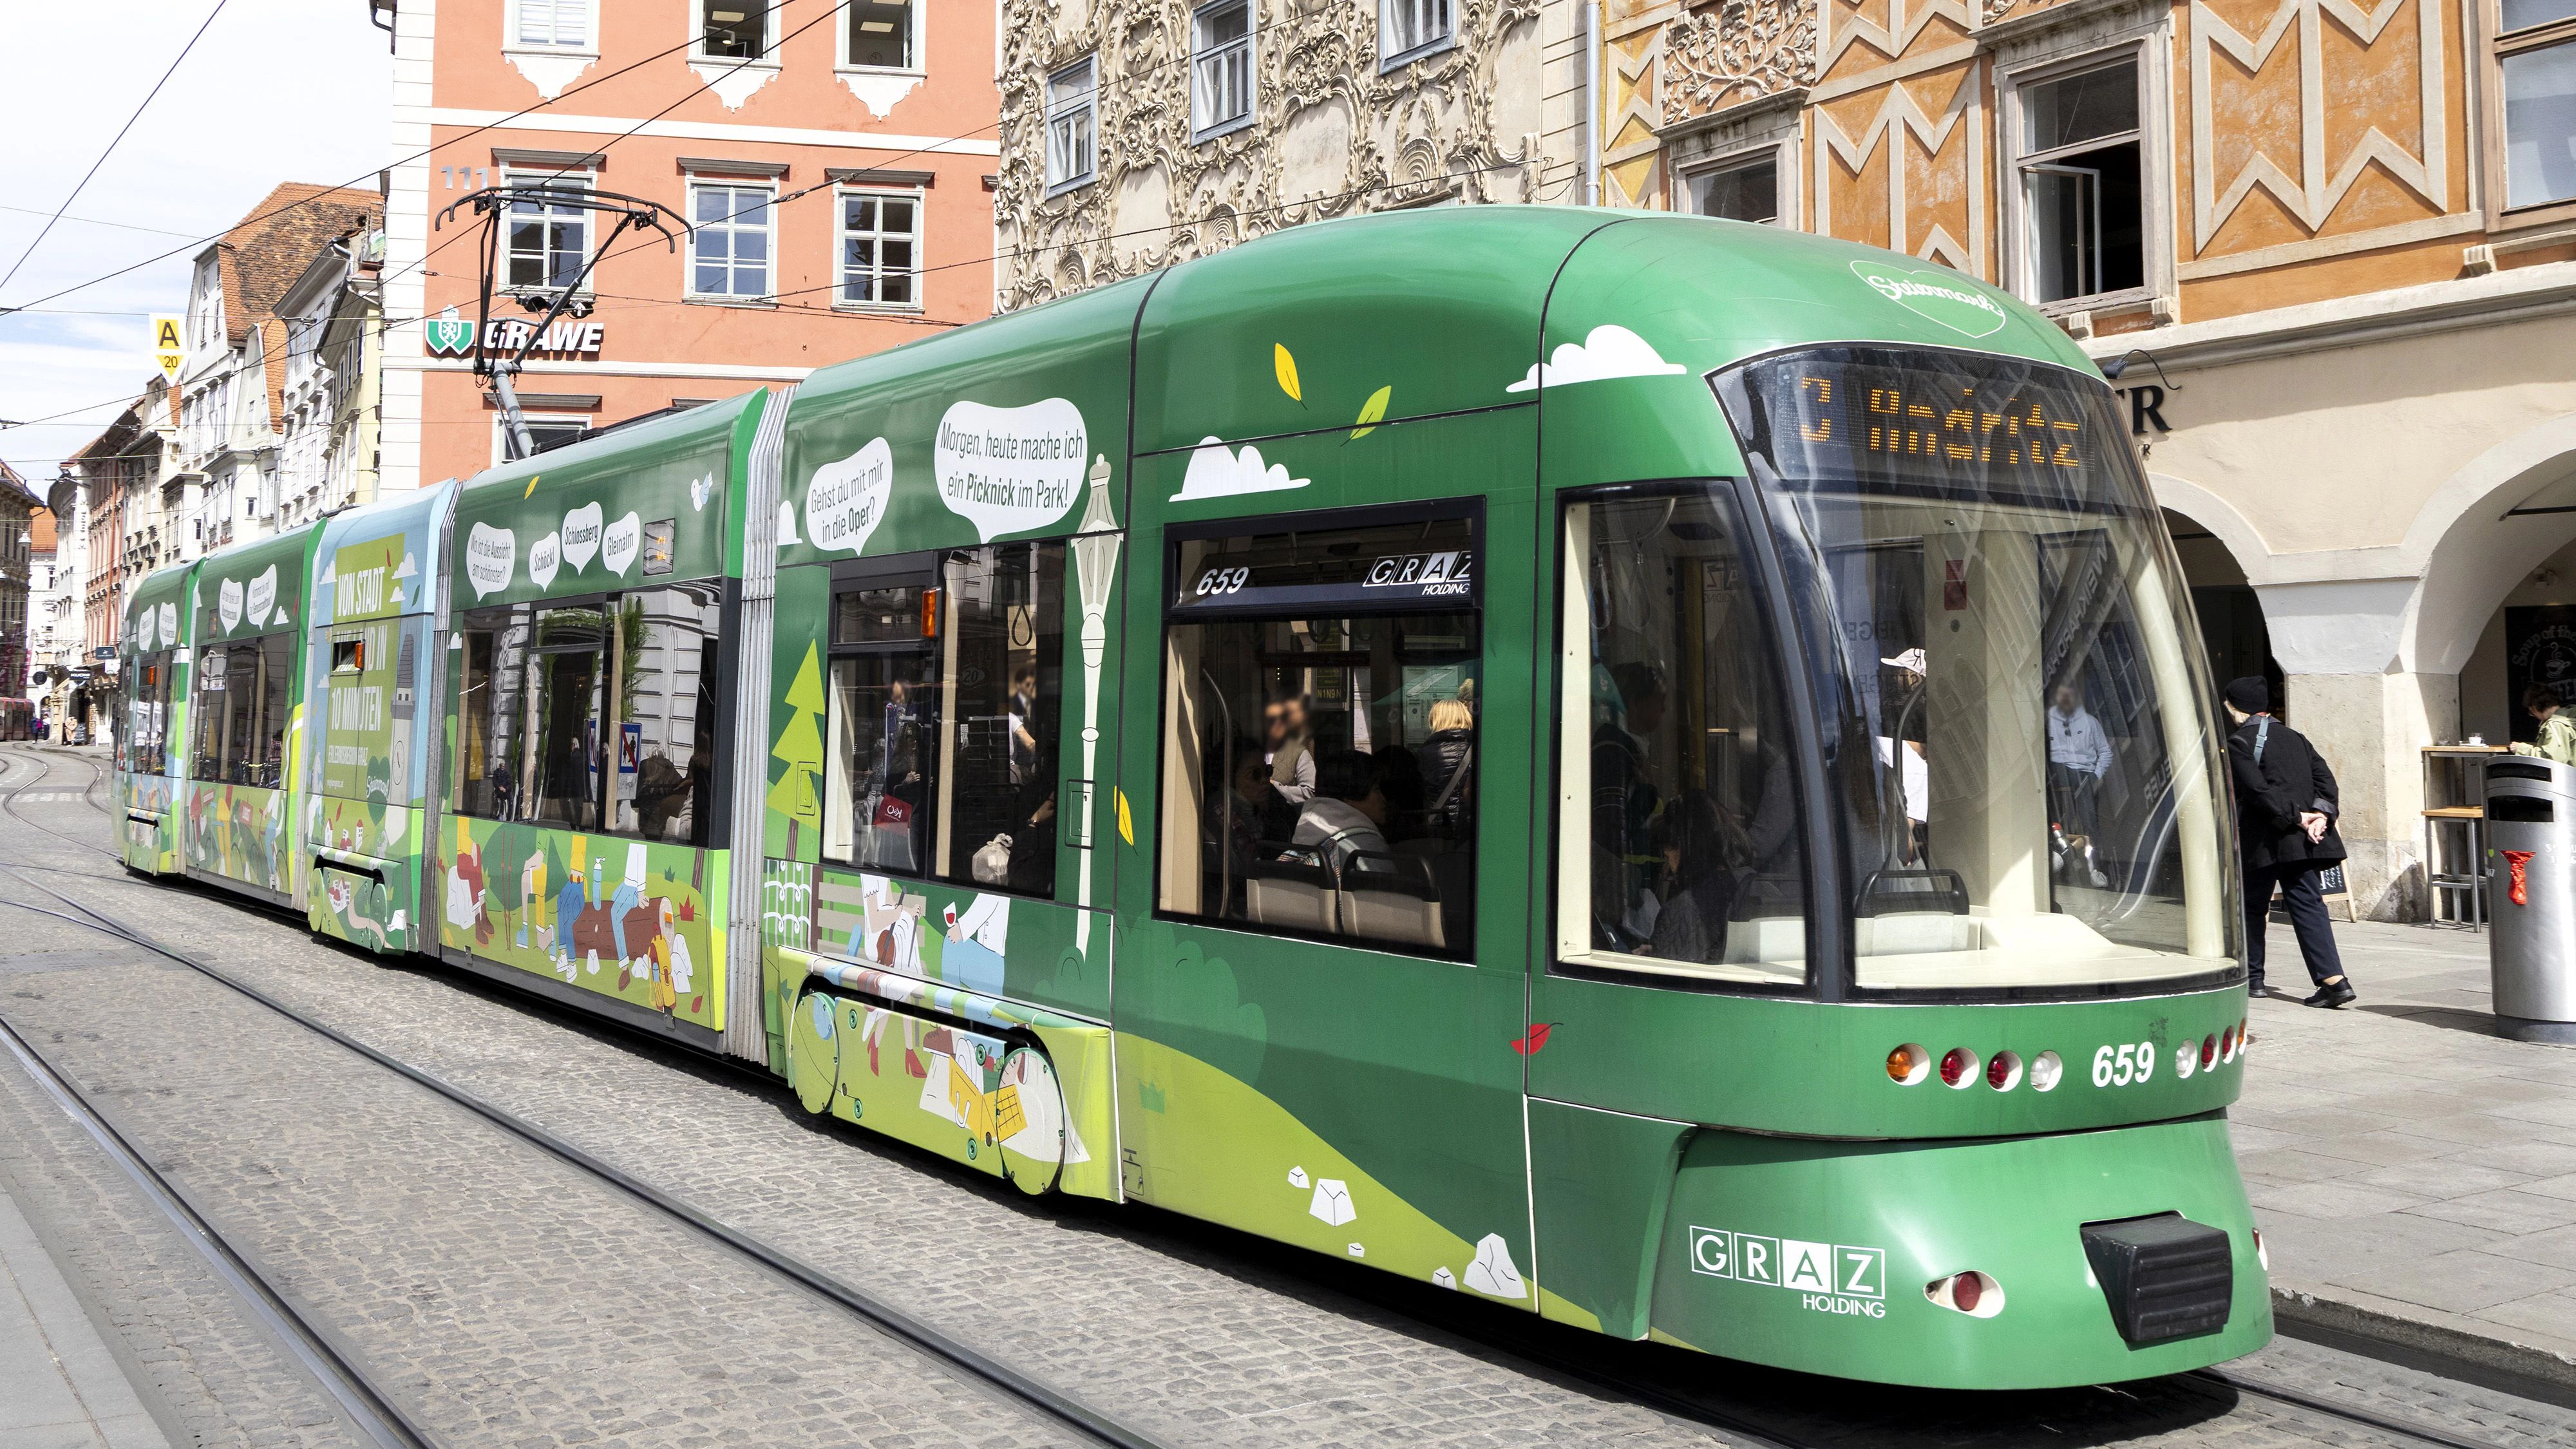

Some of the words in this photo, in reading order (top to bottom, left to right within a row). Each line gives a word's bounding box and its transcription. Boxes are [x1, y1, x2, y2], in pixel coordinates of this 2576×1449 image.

[440, 165, 488, 190] 111
[1867, 273, 2005, 315] Steiermark
[158, 321, 180, 346] A
[484, 321, 604, 352] GRAWE
[164, 355, 178, 368] 20
[940, 422, 982, 460] Morgen,
[985, 431, 1017, 460] heute
[1021, 431, 1061, 460] mache
[1065, 430, 1083, 459] ich
[811, 485, 836, 515] Gehst
[837, 479, 849, 506] du
[851, 470, 867, 500] mit
[868, 460, 884, 489] mir
[948, 471, 964, 500] ein
[967, 473, 1015, 507] Picknick
[1018, 478, 1033, 507] im
[1036, 478, 1068, 509] Park!
[565, 523, 598, 546] Schlossberg
[822, 519, 831, 544] in
[833, 512, 847, 540] die
[848, 497, 876, 536] Oper?
[491, 540, 511, 560] Aussicht
[607, 530, 634, 556] Gleinalm
[472, 565, 479, 577] am
[480, 565, 506, 583] schönsten?
[534, 546, 555, 573] Schöckl
[1367, 552, 1471, 585] GRAZ
[337, 573, 355, 616] VON
[355, 567, 385, 615] STADT
[1196, 567, 1249, 596] 659
[1422, 582, 1470, 596] HOLDING
[376, 625, 388, 670] IN
[332, 687, 342, 730] 10
[342, 686, 383, 731] MINUTEN
[2092, 1041, 2155, 1088] 659
[1692, 1227, 1882, 1297] GRAZ
[1802, 1293, 1886, 1319] HOLDING
